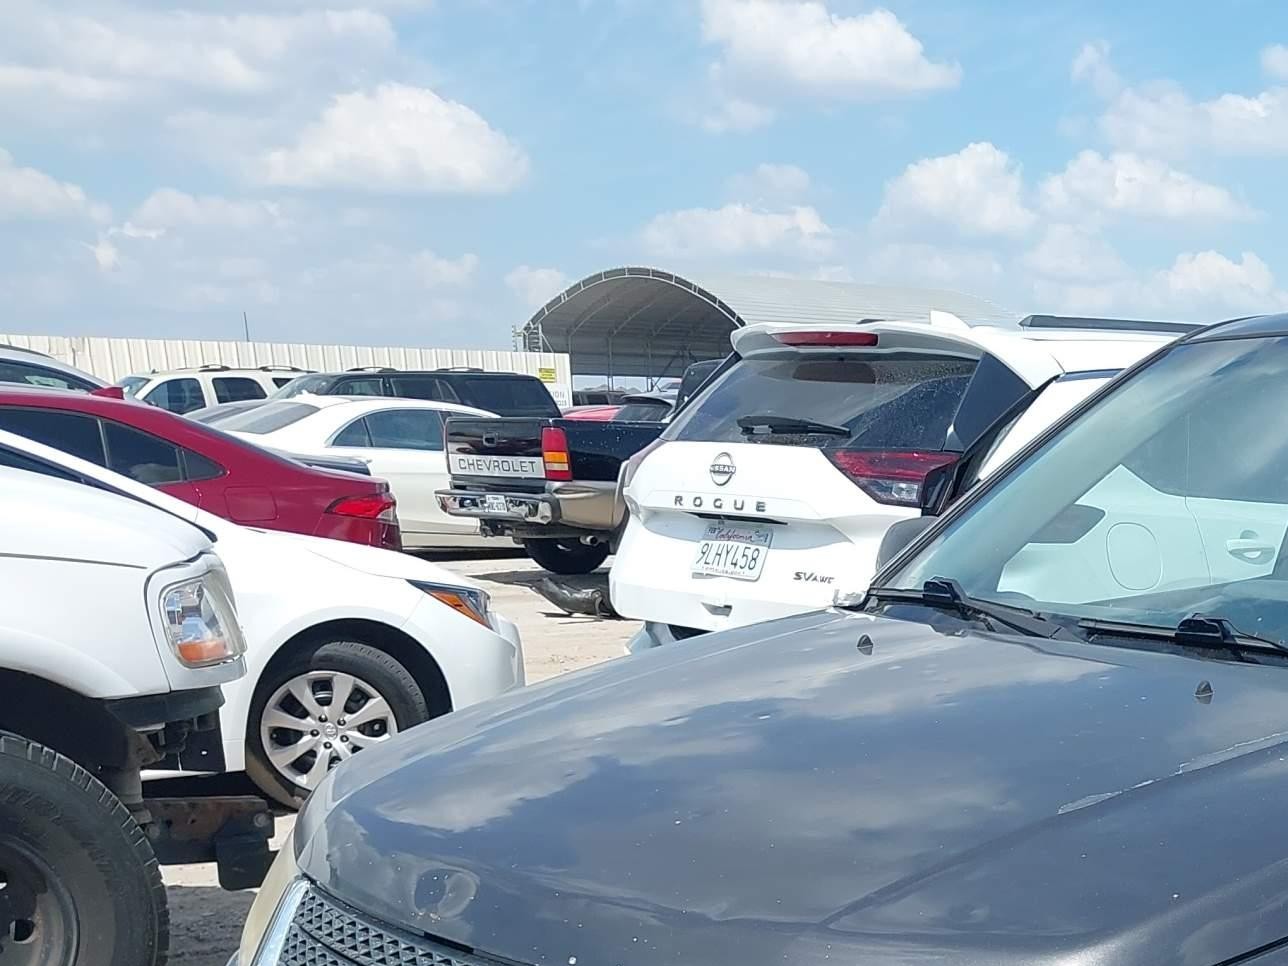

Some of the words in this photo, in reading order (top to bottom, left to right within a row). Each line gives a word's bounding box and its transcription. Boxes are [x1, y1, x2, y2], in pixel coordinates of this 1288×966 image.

[458, 458, 536, 473] CHEVROLET
[674, 495, 766, 512] ROGUE
[696, 542, 760, 570] 9LHY458
[793, 571, 814, 582] SV
